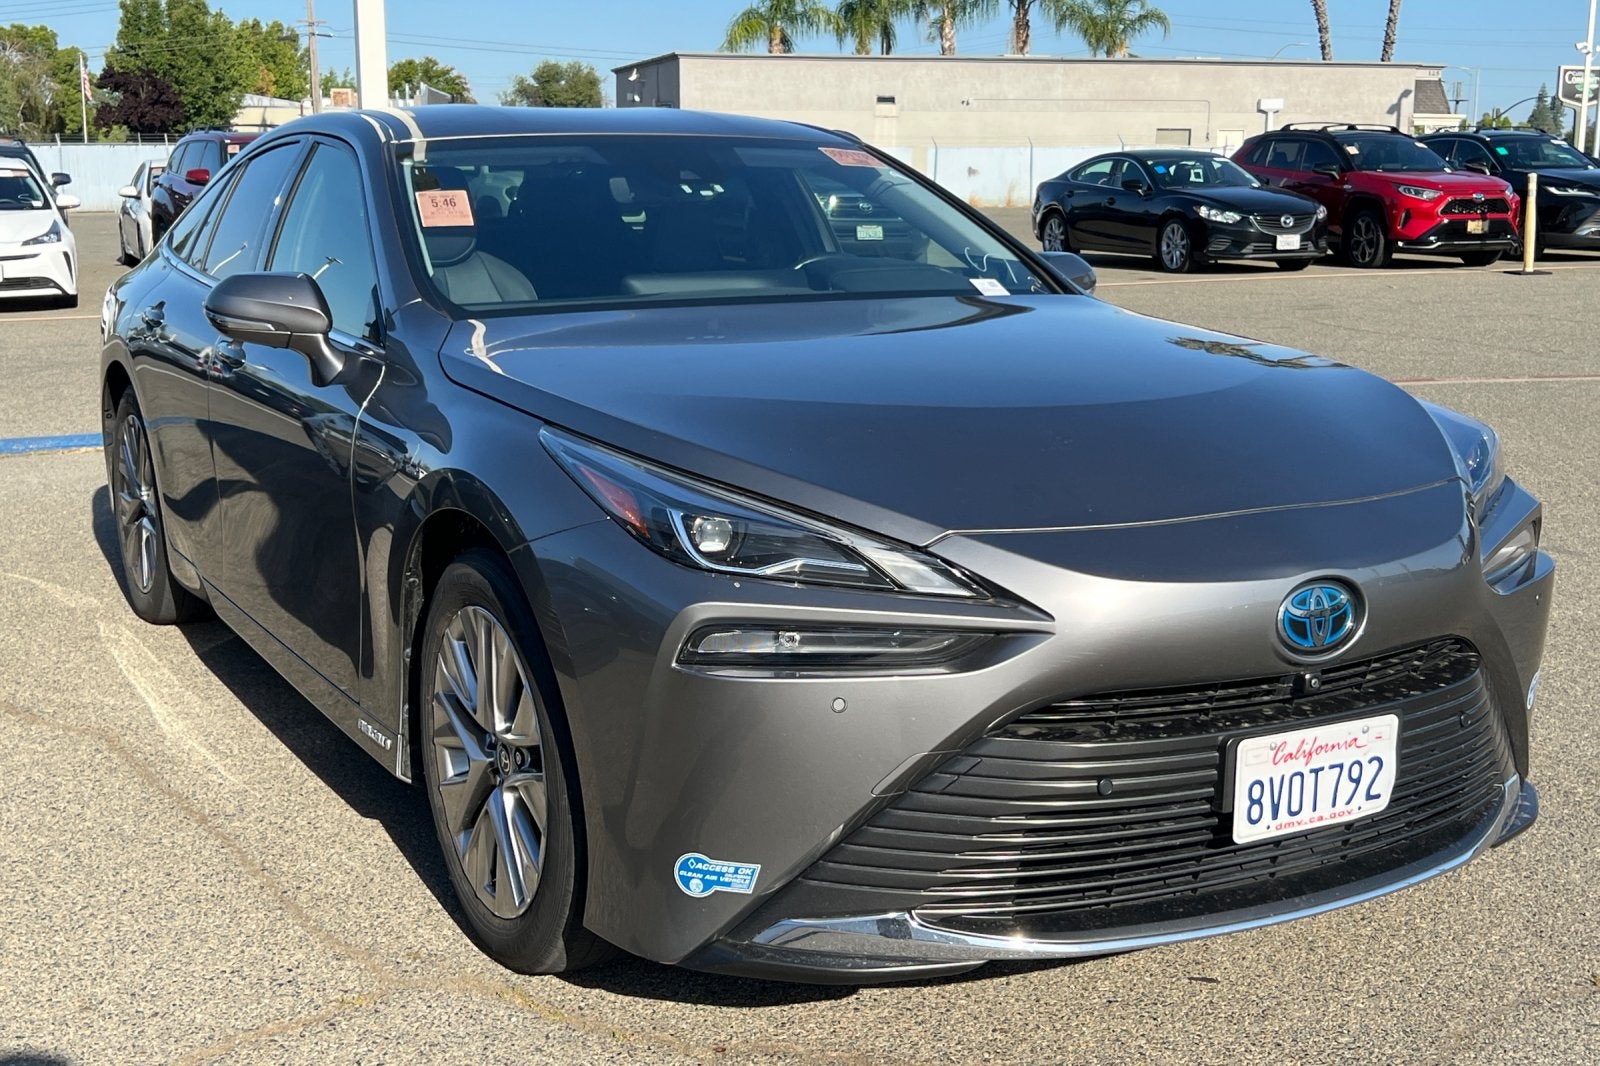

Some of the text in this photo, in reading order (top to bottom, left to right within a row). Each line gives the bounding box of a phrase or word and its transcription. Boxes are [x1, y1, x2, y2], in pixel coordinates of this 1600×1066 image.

[1272, 735, 1368, 767] California
[1275, 808, 1355, 832] dmv.ca.gov
[679, 870, 704, 879] CLEAN
[719, 876, 751, 885] VEHICLE
[695, 863, 754, 876] ACCESS OK
